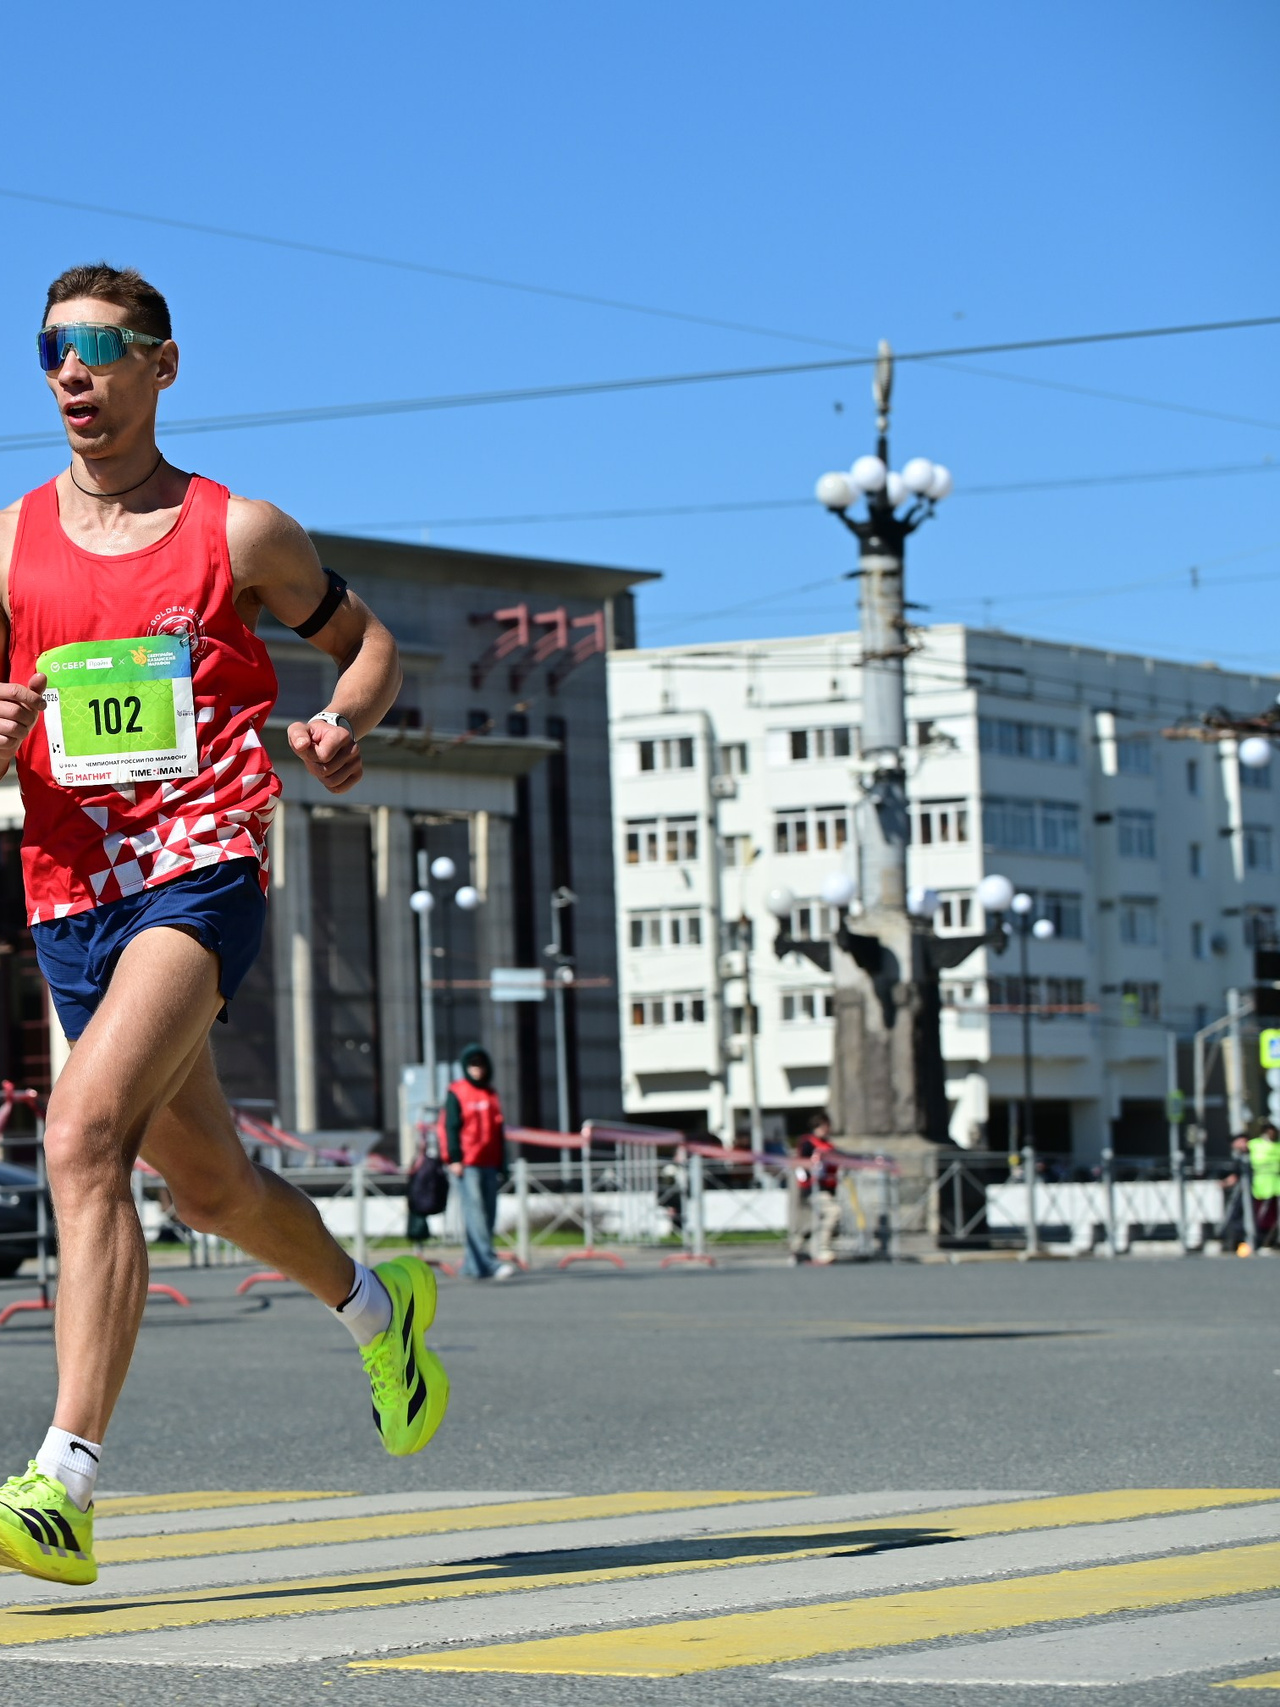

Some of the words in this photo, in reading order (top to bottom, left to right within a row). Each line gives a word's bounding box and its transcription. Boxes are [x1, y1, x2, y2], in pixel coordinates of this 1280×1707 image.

[150, 605, 185, 626] GOLDEN
[61, 660, 85, 670] СБЕР
[88, 695, 143, 736] 102
[85, 759, 120, 768] ЧЕМПИОНАТ
[120, 757, 145, 765] РОССИИ
[155, 754, 187, 762] МАРАФОНУ
[75, 771, 112, 781] МАГНИТ
